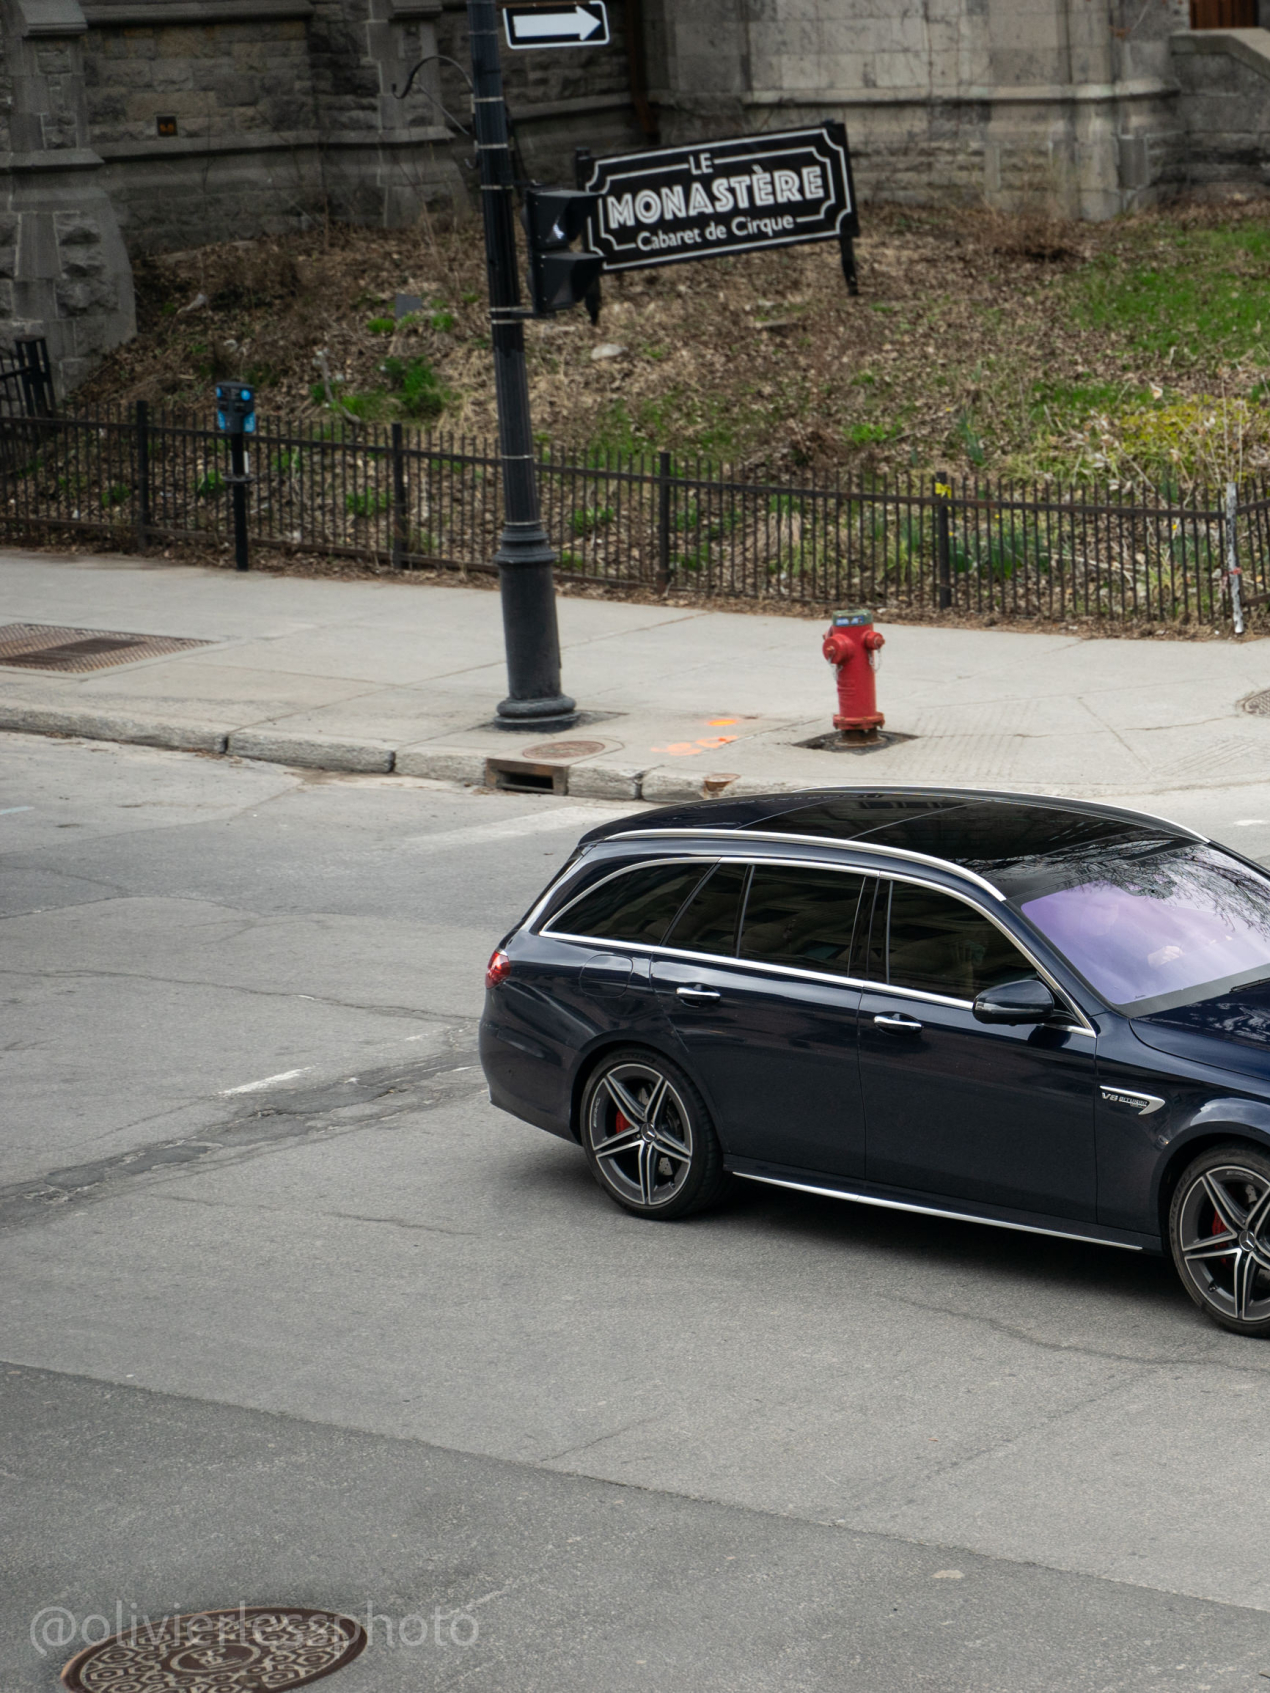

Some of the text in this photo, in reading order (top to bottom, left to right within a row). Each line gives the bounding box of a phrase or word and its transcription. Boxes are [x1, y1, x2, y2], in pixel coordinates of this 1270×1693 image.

[689, 153, 715, 175] LE
[607, 164, 825, 229] MONASTÈRE
[637, 215, 795, 251] Cabaret de Cirque
[1101, 1092, 1118, 1102] V8
